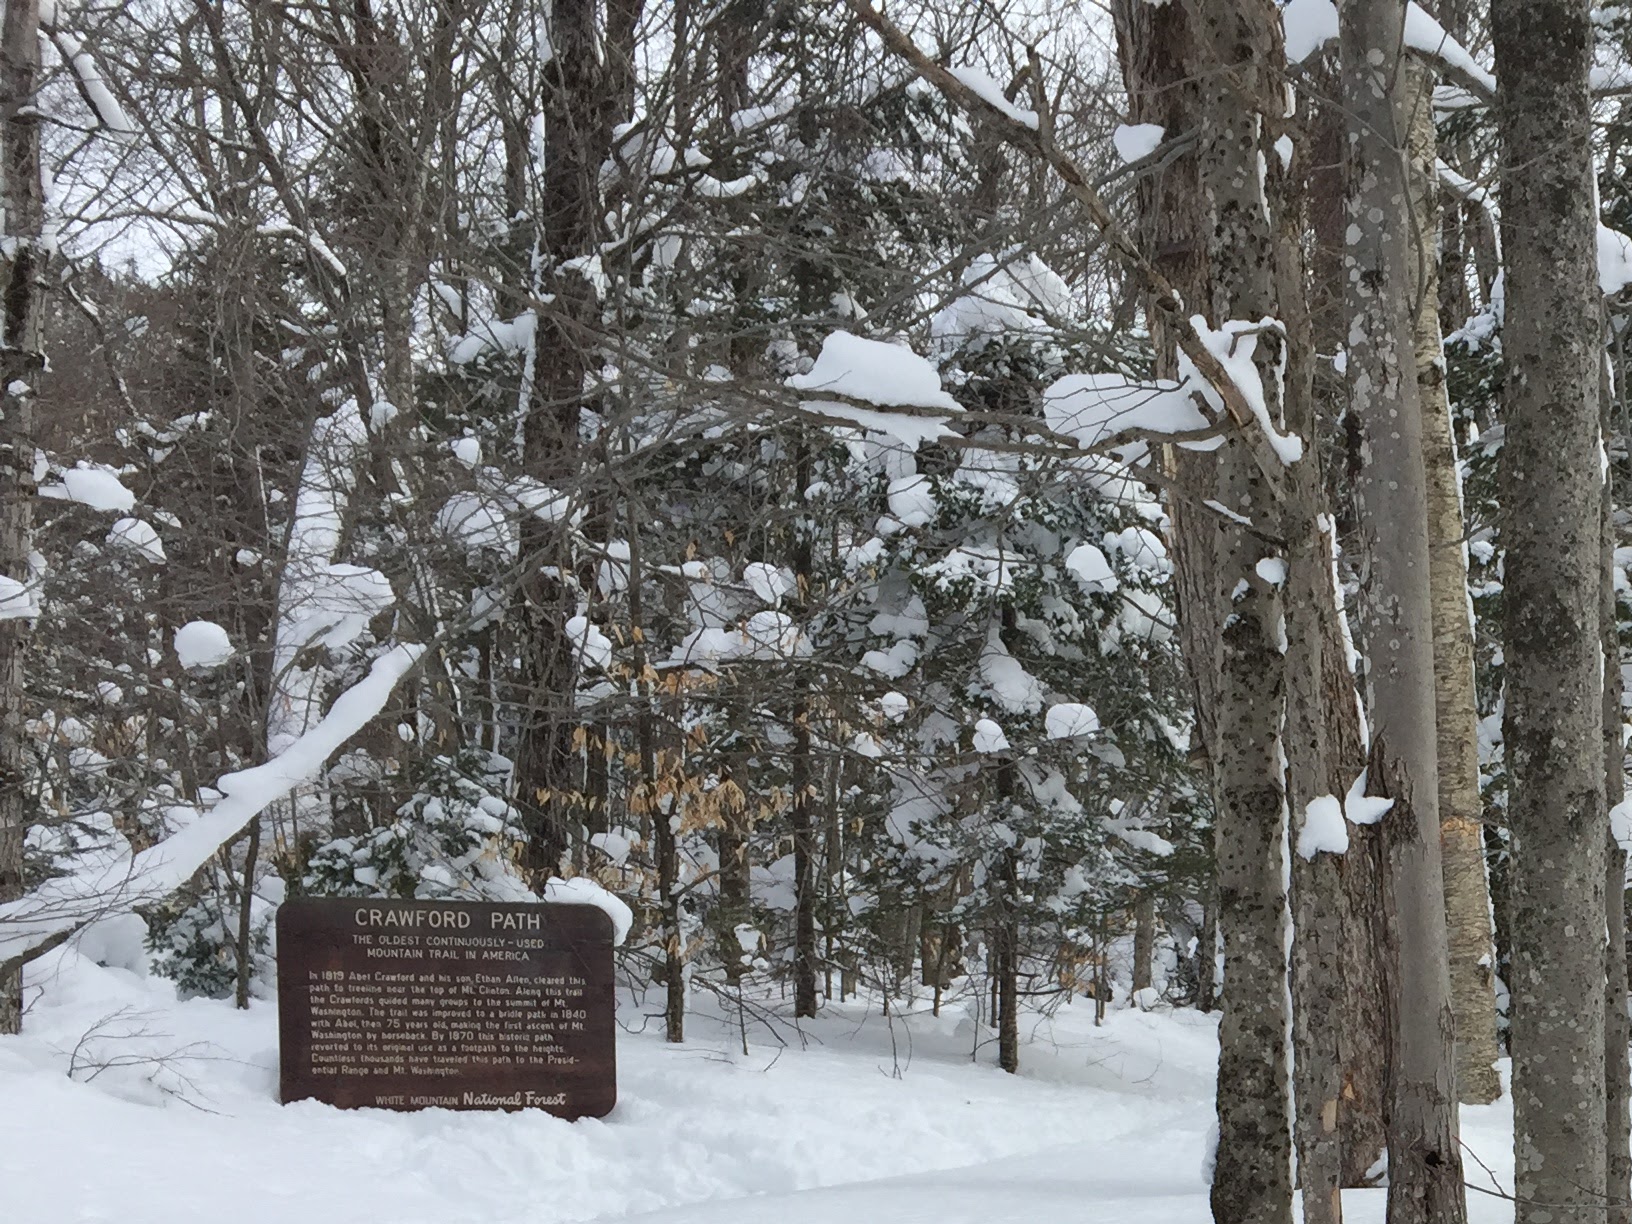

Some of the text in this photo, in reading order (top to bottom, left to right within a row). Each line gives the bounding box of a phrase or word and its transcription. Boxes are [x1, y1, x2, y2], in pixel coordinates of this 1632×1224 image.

[355, 908, 540, 929] CRAWFORD PATH
[352, 934, 372, 944] THE
[378, 936, 420, 945] OLDEST
[367, 948, 529, 960] MOUNTAIN TRAIL IN AMERICA
[309, 971, 318, 980] In
[349, 971, 371, 980] Abel
[375, 971, 415, 982] Crawford
[419, 974, 435, 982] and
[438, 974, 451, 982] his
[475, 973, 501, 983] Ethan
[534, 976, 565, 984] cleared
[309, 984, 330, 993] path
[334, 984, 344, 992] to
[348, 985, 382, 993] treeline
[430, 986, 445, 995] top
[448, 986, 457, 994] of
[516, 986, 541, 997] Along
[545, 988, 562, 996] this
[565, 988, 583, 996] trail
[310, 995, 325, 1004] the
[329, 994, 374, 1005] Crawfords
[378, 996, 408, 1006] guided
[411, 998, 435, 1006] many
[440, 998, 468, 1007] groups
[473, 998, 483, 1006] to
[487, 998, 502, 1006] the
[505, 999, 537, 1007] summit
[369, 1007, 385, 1016] The
[390, 1008, 408, 1016] trail
[432, 1009, 472, 1019] improved
[498, 1010, 523, 1018] bridle
[527, 1011, 546, 1020] path
[561, 1009, 587, 1019] 1840
[311, 1020, 331, 1028] with
[361, 1020, 382, 1028] then
[386, 1018, 401, 1028] 75
[405, 1021, 428, 1030] years
[450, 1021, 481, 1031] making
[485, 1021, 500, 1029] the
[504, 1021, 522, 1030] first
[526, 1022, 554, 1030] ascent
[559, 1022, 568, 1030] of
[311, 1030, 362, 1041] Washington
[366, 1031, 378, 1041] by
[431, 1030, 445, 1041] By
[449, 1031, 474, 1041] 1870
[498, 1033, 530, 1041] historic
[534, 1034, 554, 1042] path
[310, 1043, 350, 1052] reverted
[353, 1043, 363, 1051] to
[366, 1043, 379, 1051] its
[382, 1044, 415, 1053] original
[460, 1044, 497, 1053] footpath
[501, 1044, 511, 1052] to
[514, 1045, 529, 1053] the
[311, 1053, 356, 1063] Countless
[360, 1054, 404, 1063] thousands
[408, 1055, 429, 1063] have
[432, 1055, 468, 1064] traveled
[471, 1056, 488, 1064] this
[492, 1056, 512, 1065] path
[515, 1056, 525, 1064] to
[529, 1056, 544, 1064] the
[311, 1066, 337, 1075] ential
[341, 1065, 369, 1077] Range
[373, 1067, 389, 1075] and
[375, 1091, 566, 1106] WHITE MOUNTAIN National Forest
